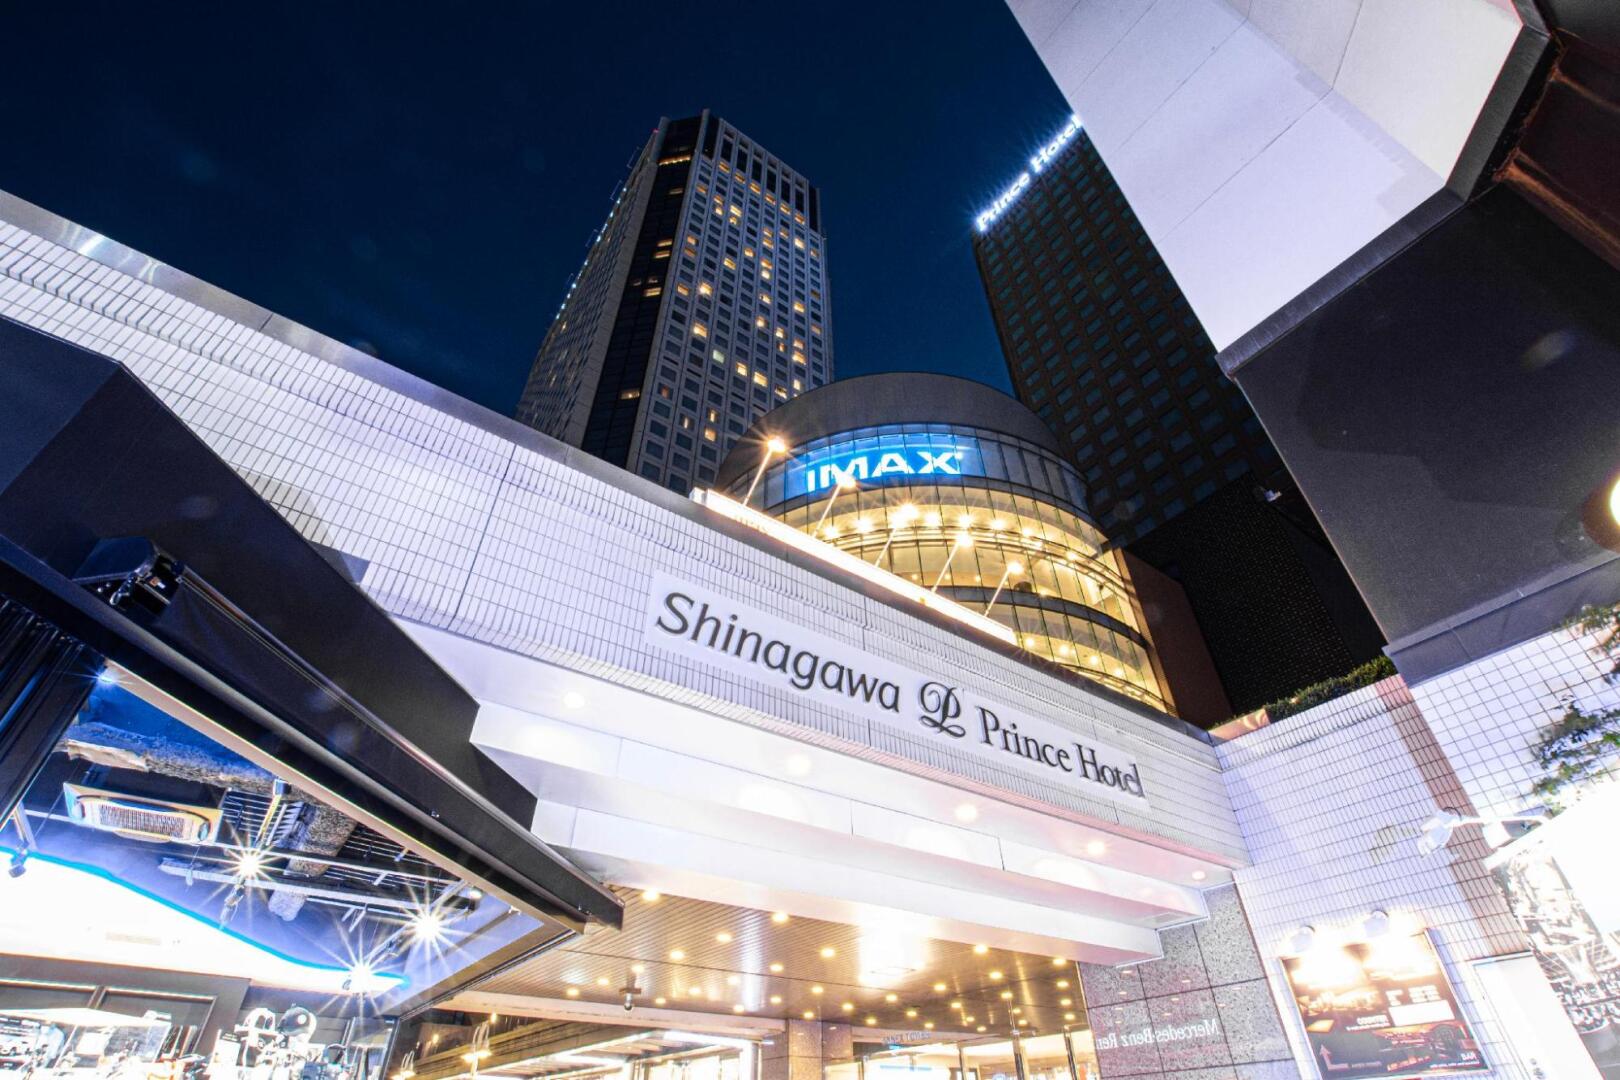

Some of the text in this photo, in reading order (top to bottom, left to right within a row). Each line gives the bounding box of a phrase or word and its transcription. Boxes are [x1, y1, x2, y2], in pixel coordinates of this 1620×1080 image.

[806, 451, 961, 493] IMAX
[656, 592, 900, 713] Shinagawa
[975, 705, 1073, 773] Prince
[1072, 742, 1146, 798] Hotel
